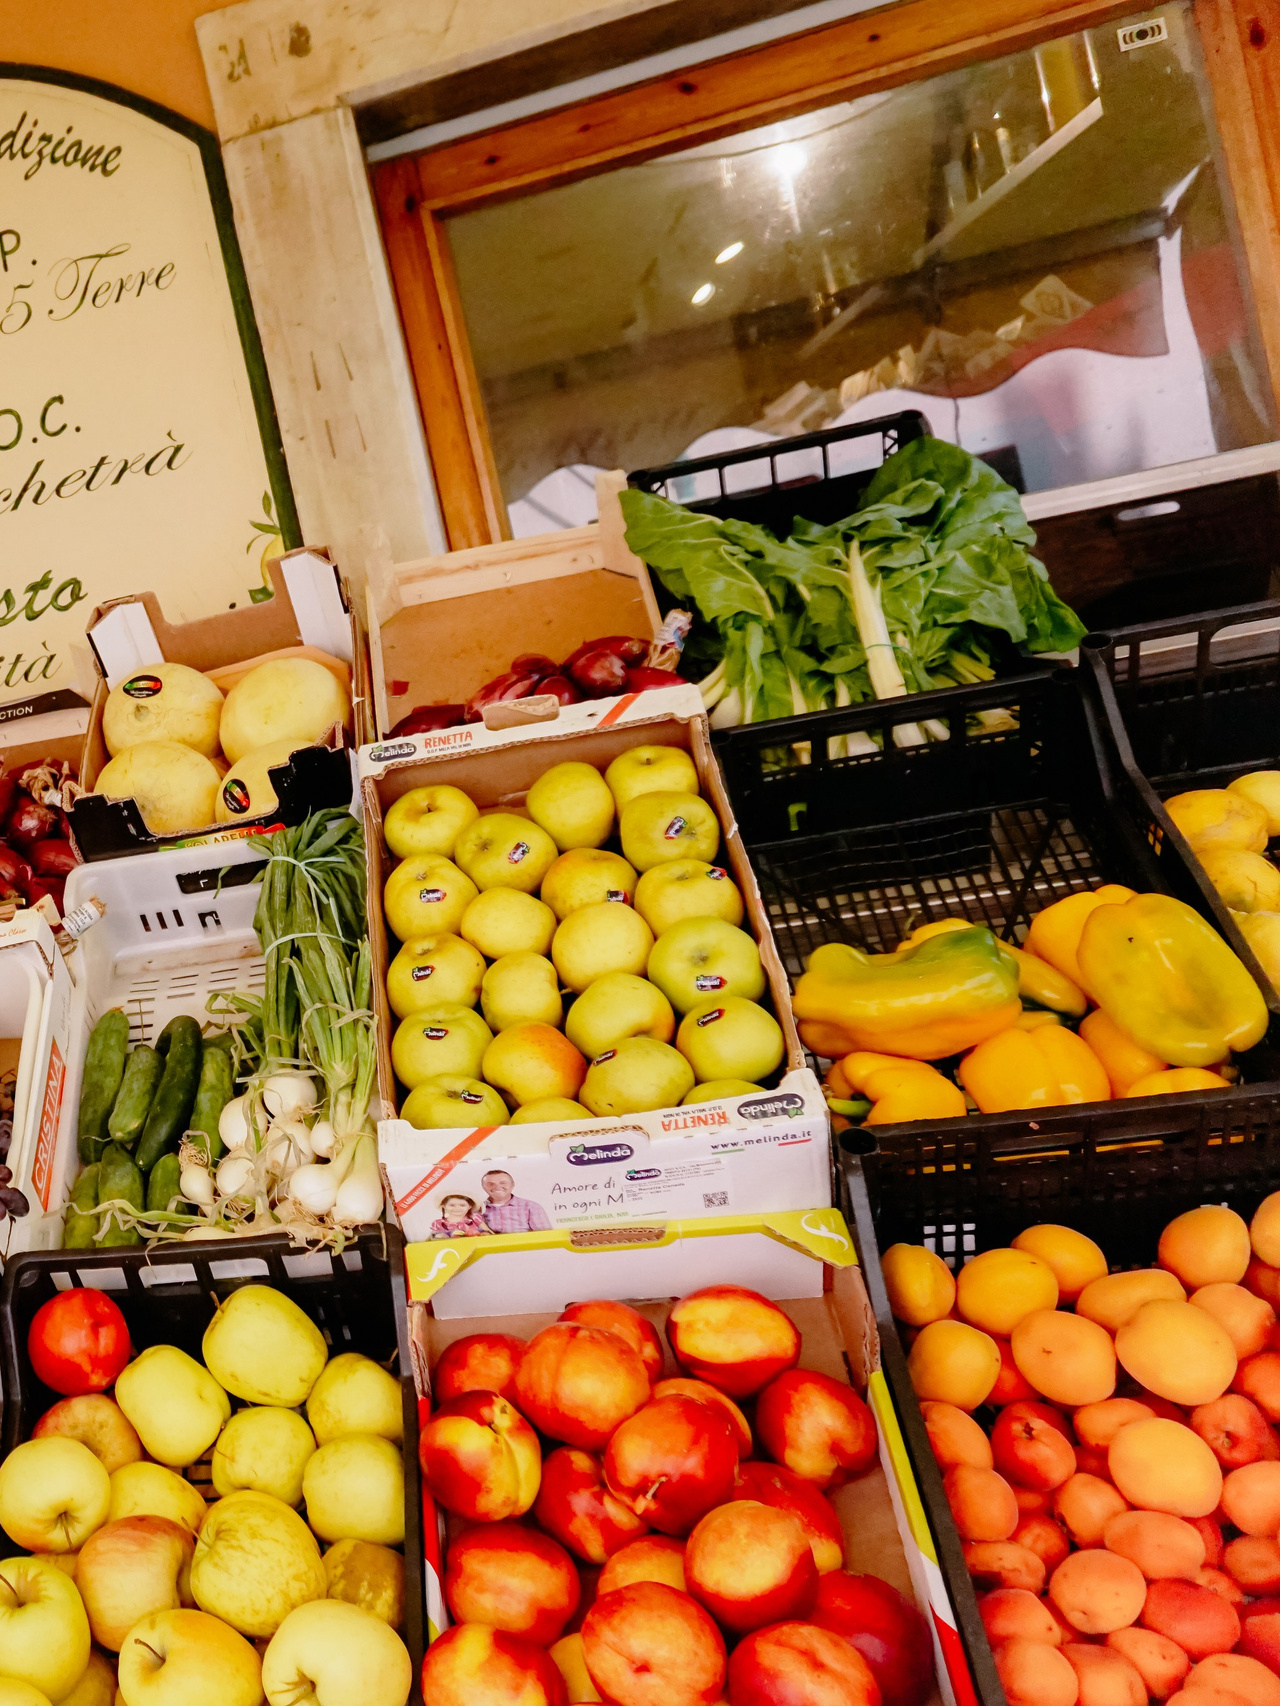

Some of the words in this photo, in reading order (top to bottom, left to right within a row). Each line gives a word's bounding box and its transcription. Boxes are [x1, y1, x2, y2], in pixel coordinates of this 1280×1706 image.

[0, 279, 34, 334] 5
[47, 242, 177, 321] Terre
[424, 731, 473, 749] RENETTA
[371, 745, 415, 759] Melinda
[740, 1097, 803, 1116] Melinda
[34, 1053, 62, 1190] CRISTINA
[661, 1111, 729, 1132] RENETTA
[710, 1130, 812, 1151] www.melinda.it
[570, 1145, 631, 1162] Melinda
[626, 1170, 661, 1181] Melinda
[551, 1182, 599, 1195] Amore
[604, 1177, 616, 1189] di
[554, 1201, 568, 1212] in
[572, 1199, 601, 1213] ogni
